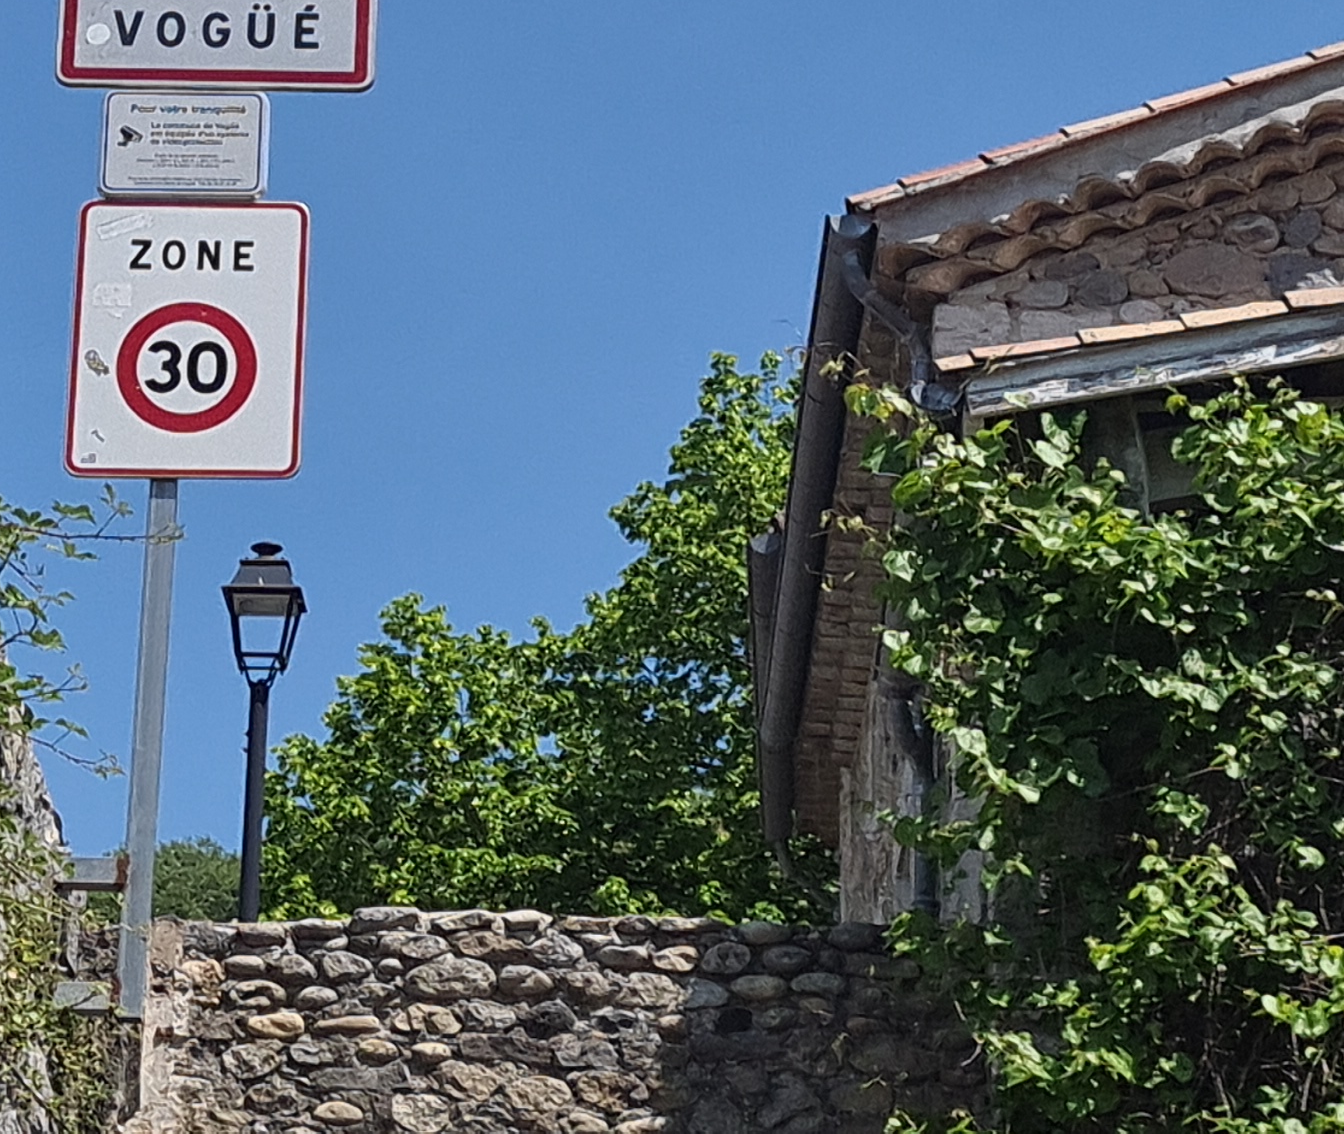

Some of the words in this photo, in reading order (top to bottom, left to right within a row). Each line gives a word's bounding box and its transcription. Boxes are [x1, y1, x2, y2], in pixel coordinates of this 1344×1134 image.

[113, 3, 320, 50] VOGÜÉ
[129, 239, 255, 272] ZONE
[144, 340, 228, 394] 30
